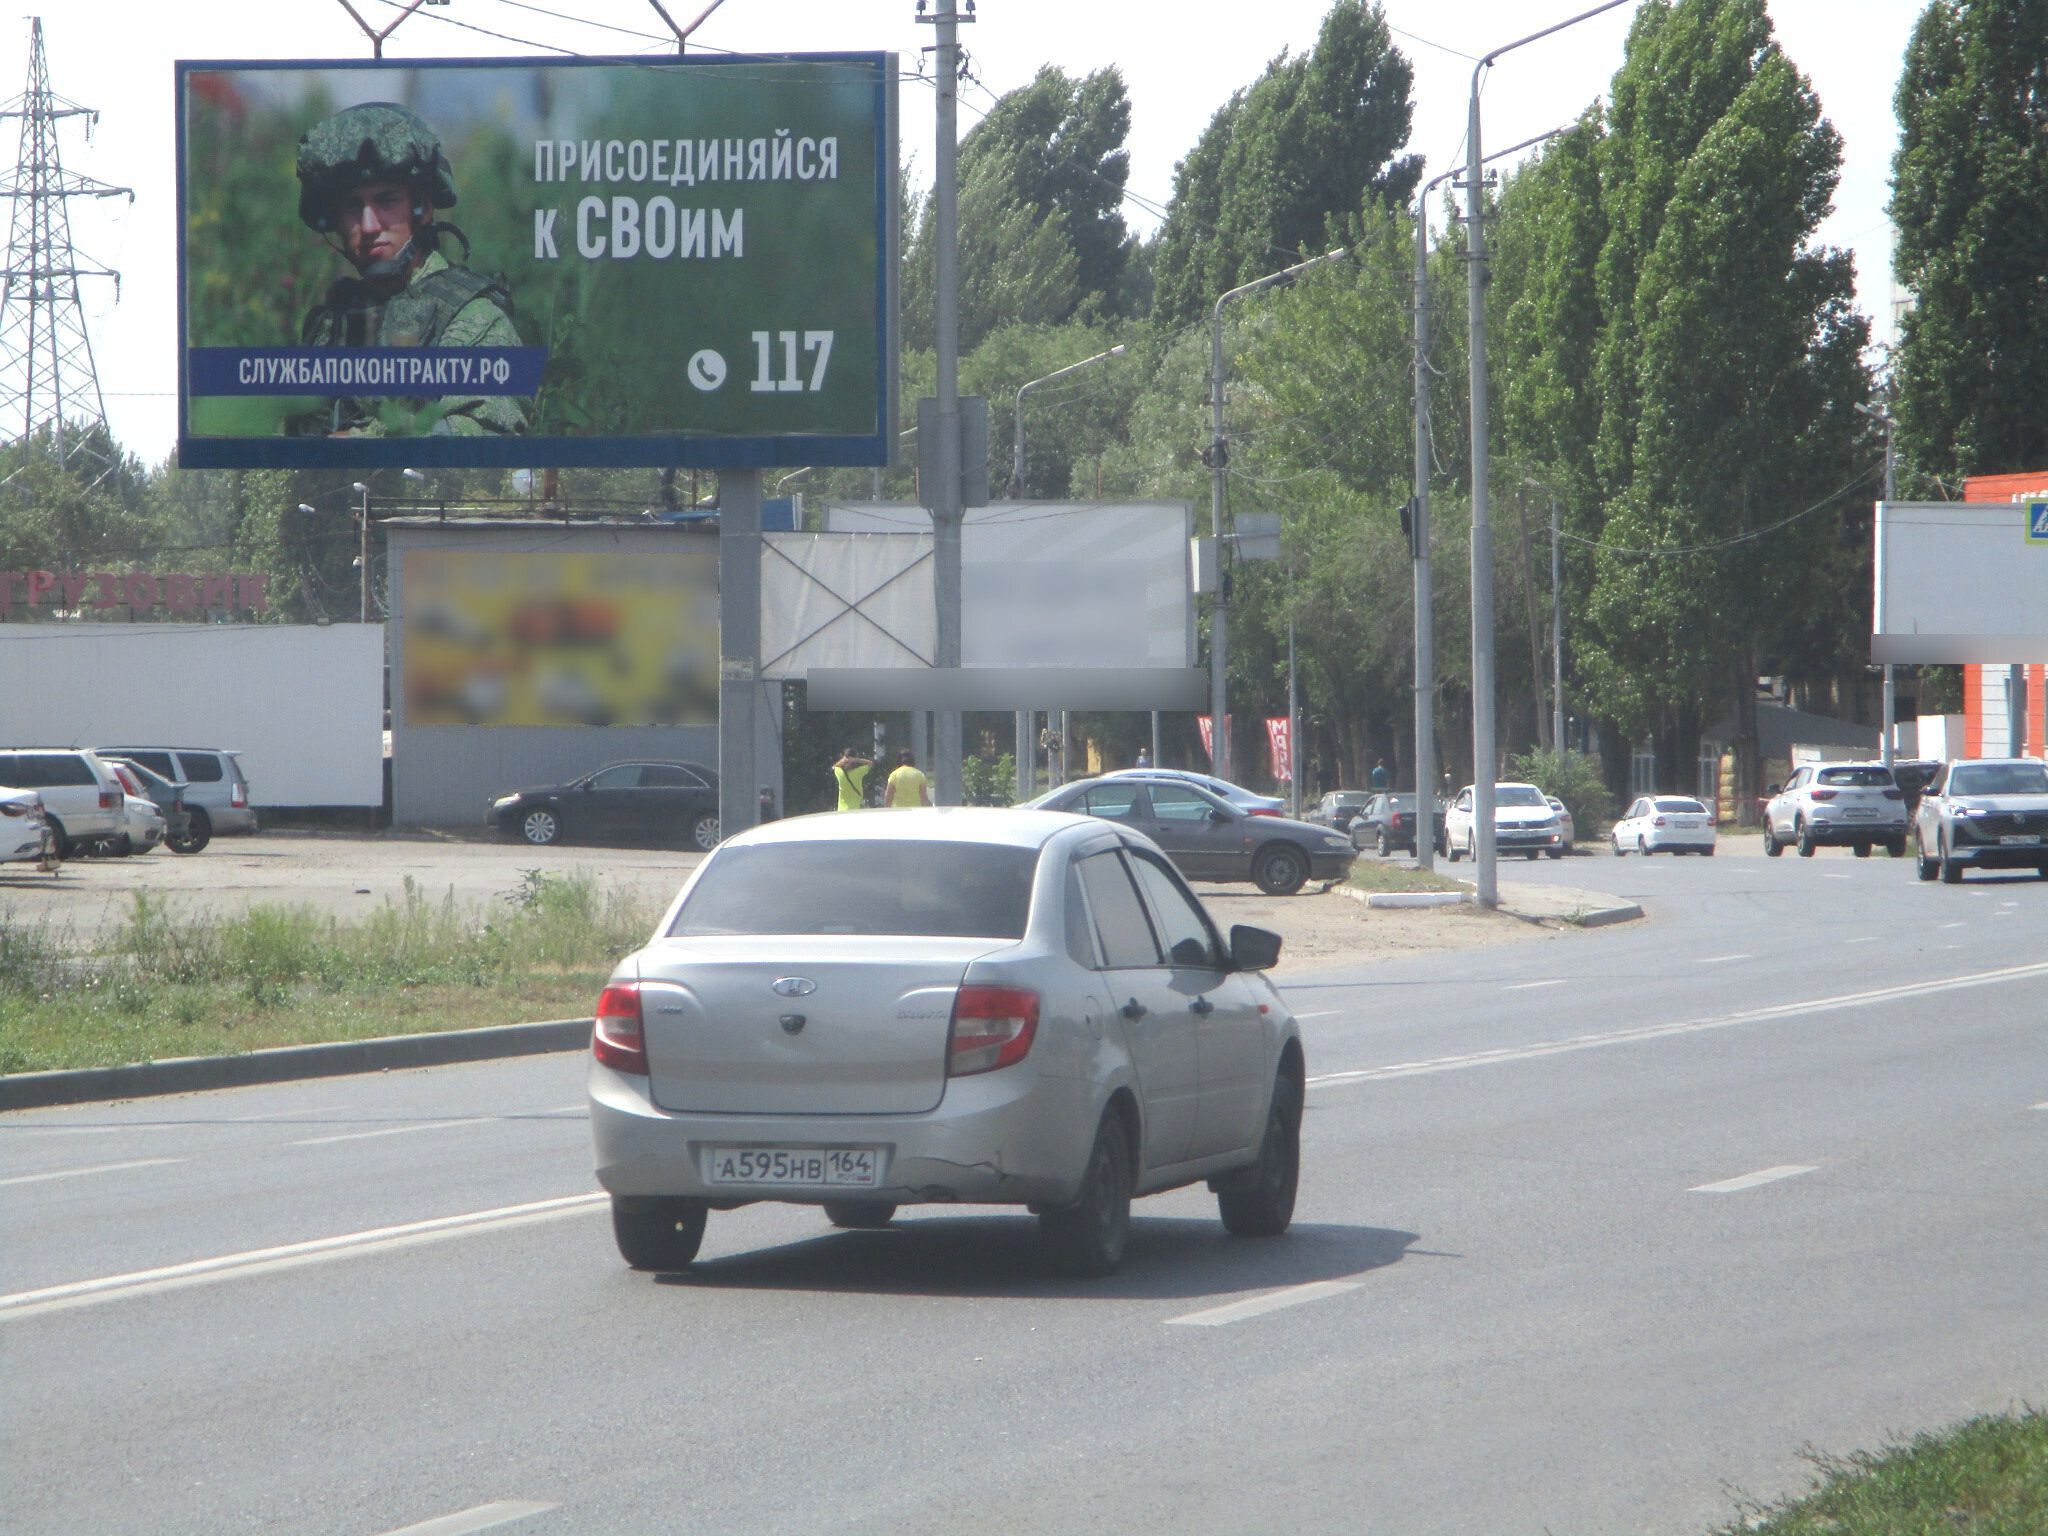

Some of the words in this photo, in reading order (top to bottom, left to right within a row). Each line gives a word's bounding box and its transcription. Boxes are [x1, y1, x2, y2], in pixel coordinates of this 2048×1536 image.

[534, 128, 838, 187] ПРИСОЕДИНЯЙСЯ
[238, 357, 511, 385] СЛУЖБАПОКОНТРАКТУ.РФ
[750, 330, 835, 391] 117
[829, 1152, 871, 1173] 164
